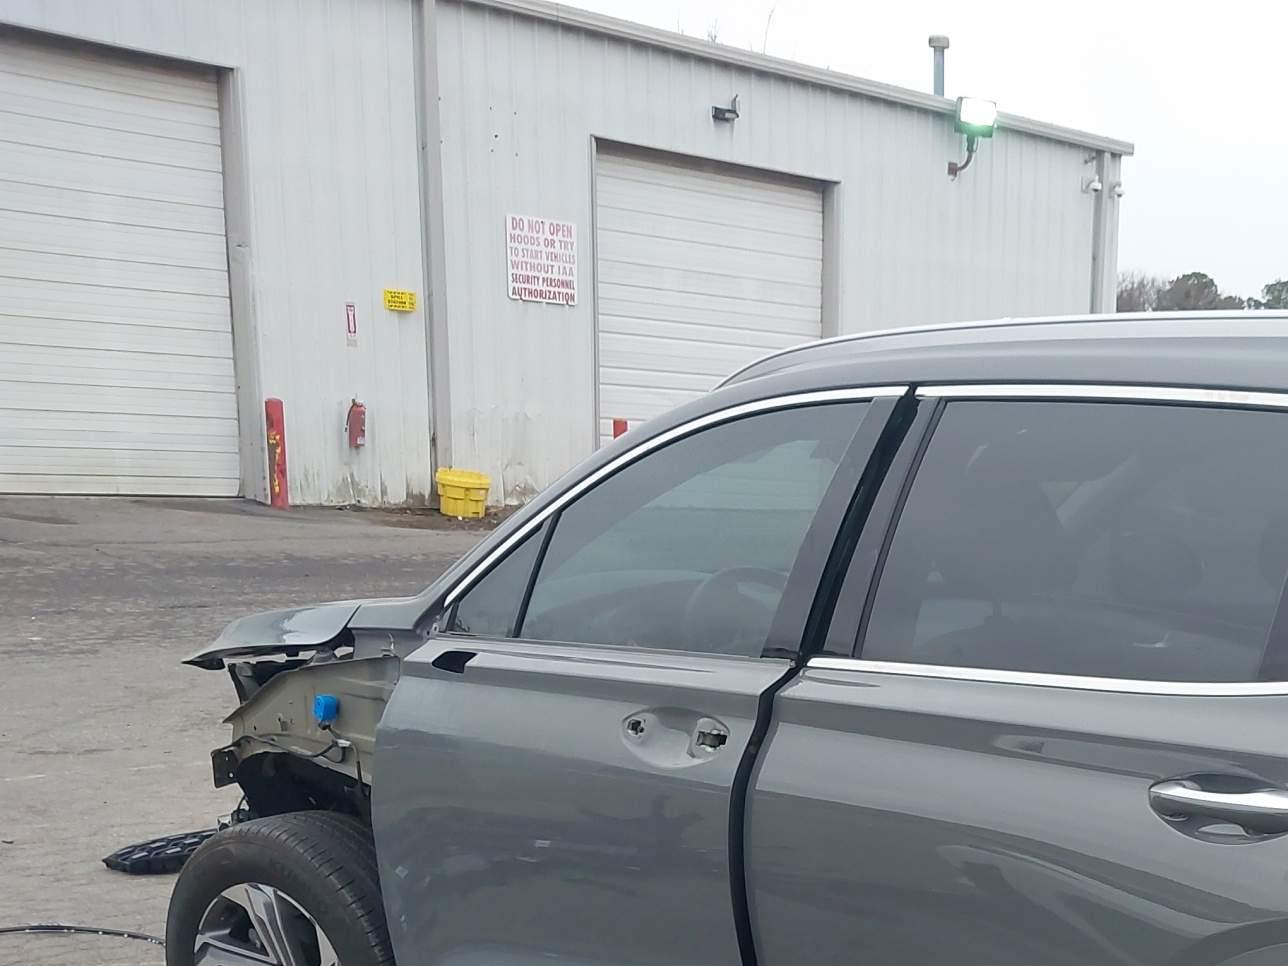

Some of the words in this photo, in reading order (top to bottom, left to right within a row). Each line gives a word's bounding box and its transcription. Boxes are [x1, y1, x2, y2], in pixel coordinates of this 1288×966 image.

[511, 217, 524, 232] DO
[527, 218, 545, 235] NOT
[549, 222, 573, 239] OPEN
[510, 233, 541, 247] HOODS
[543, 238, 556, 249] OR
[558, 239, 575, 252] TRY
[510, 246, 519, 258] TO
[521, 247, 543, 261] START
[545, 251, 576, 265] VEHICLES
[510, 259, 555, 274] WITHOUT
[558, 265, 575, 277] IAA
[511, 272, 540, 286] SECURITY
[542, 276, 576, 290] PERSONNEL
[511, 285, 576, 303] AUTHORIZATION
